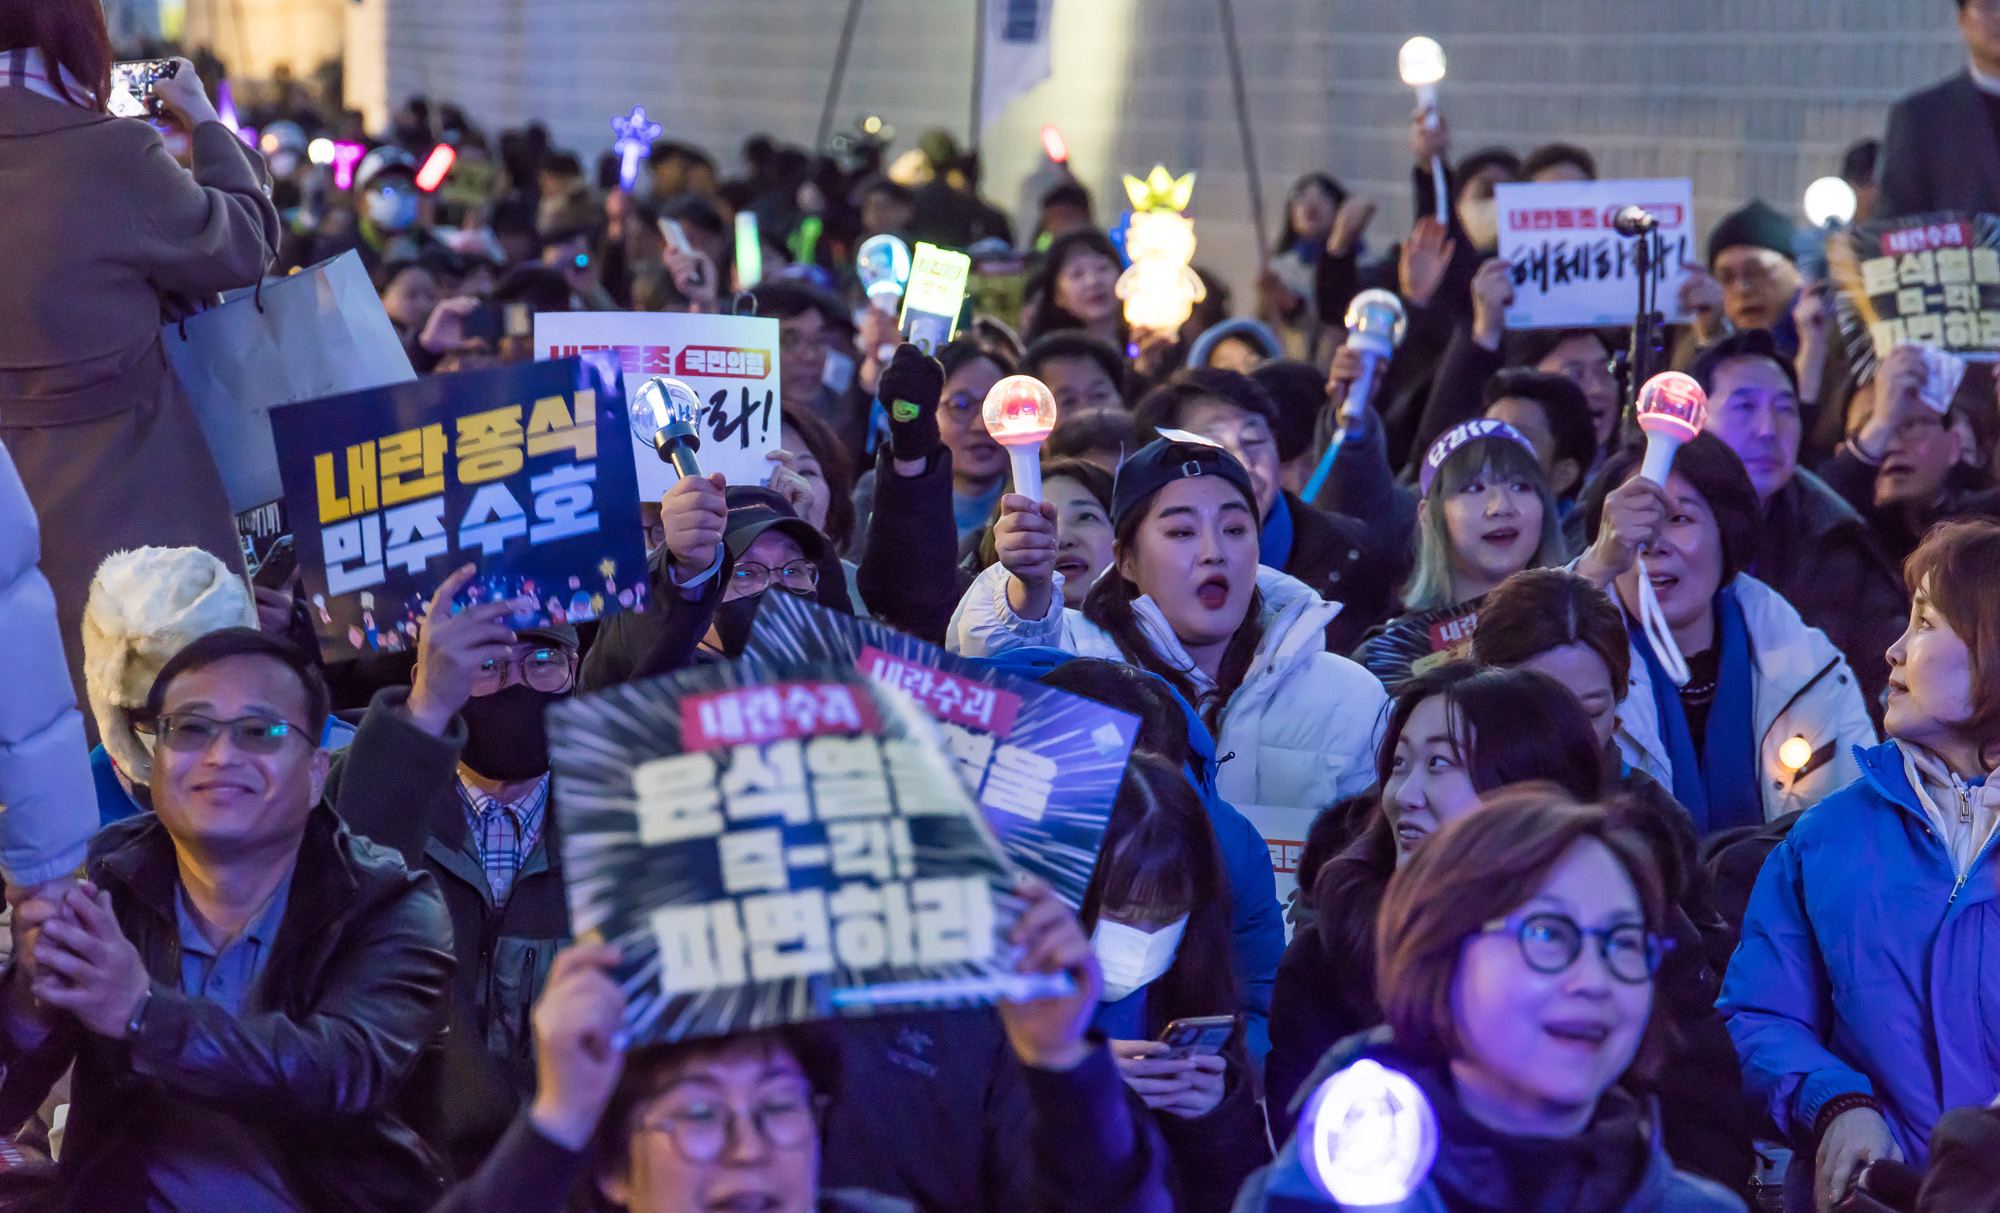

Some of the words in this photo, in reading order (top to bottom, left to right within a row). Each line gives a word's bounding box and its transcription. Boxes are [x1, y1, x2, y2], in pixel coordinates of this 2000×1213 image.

[685, 349, 765, 376] 국민의힘
[314, 423, 448, 524] 내란
[456, 388, 597, 484] 종식
[321, 496, 448, 597] 민주
[459, 463, 600, 556] 수호
[652, 875, 997, 993] 파면하라
